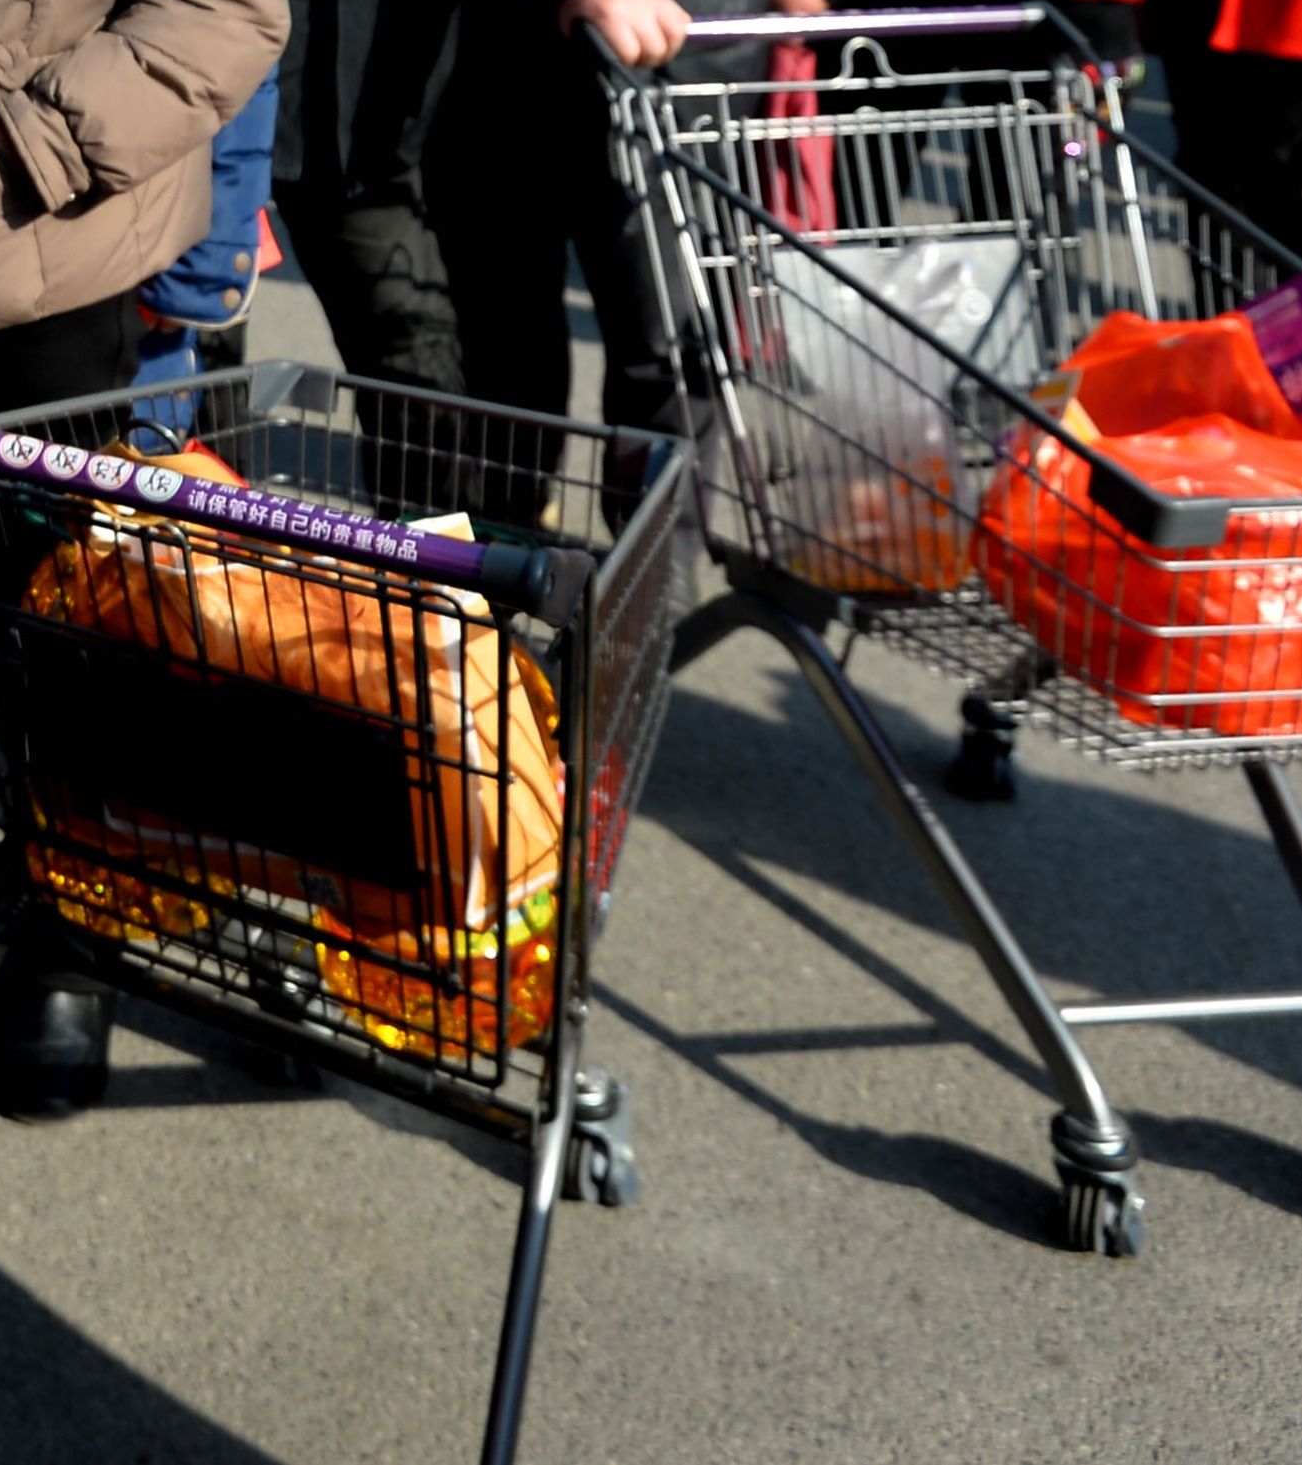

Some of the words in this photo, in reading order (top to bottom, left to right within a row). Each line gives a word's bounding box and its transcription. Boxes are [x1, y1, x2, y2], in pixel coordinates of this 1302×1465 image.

[187, 488, 418, 563] 请保管好自己的贵重物品
